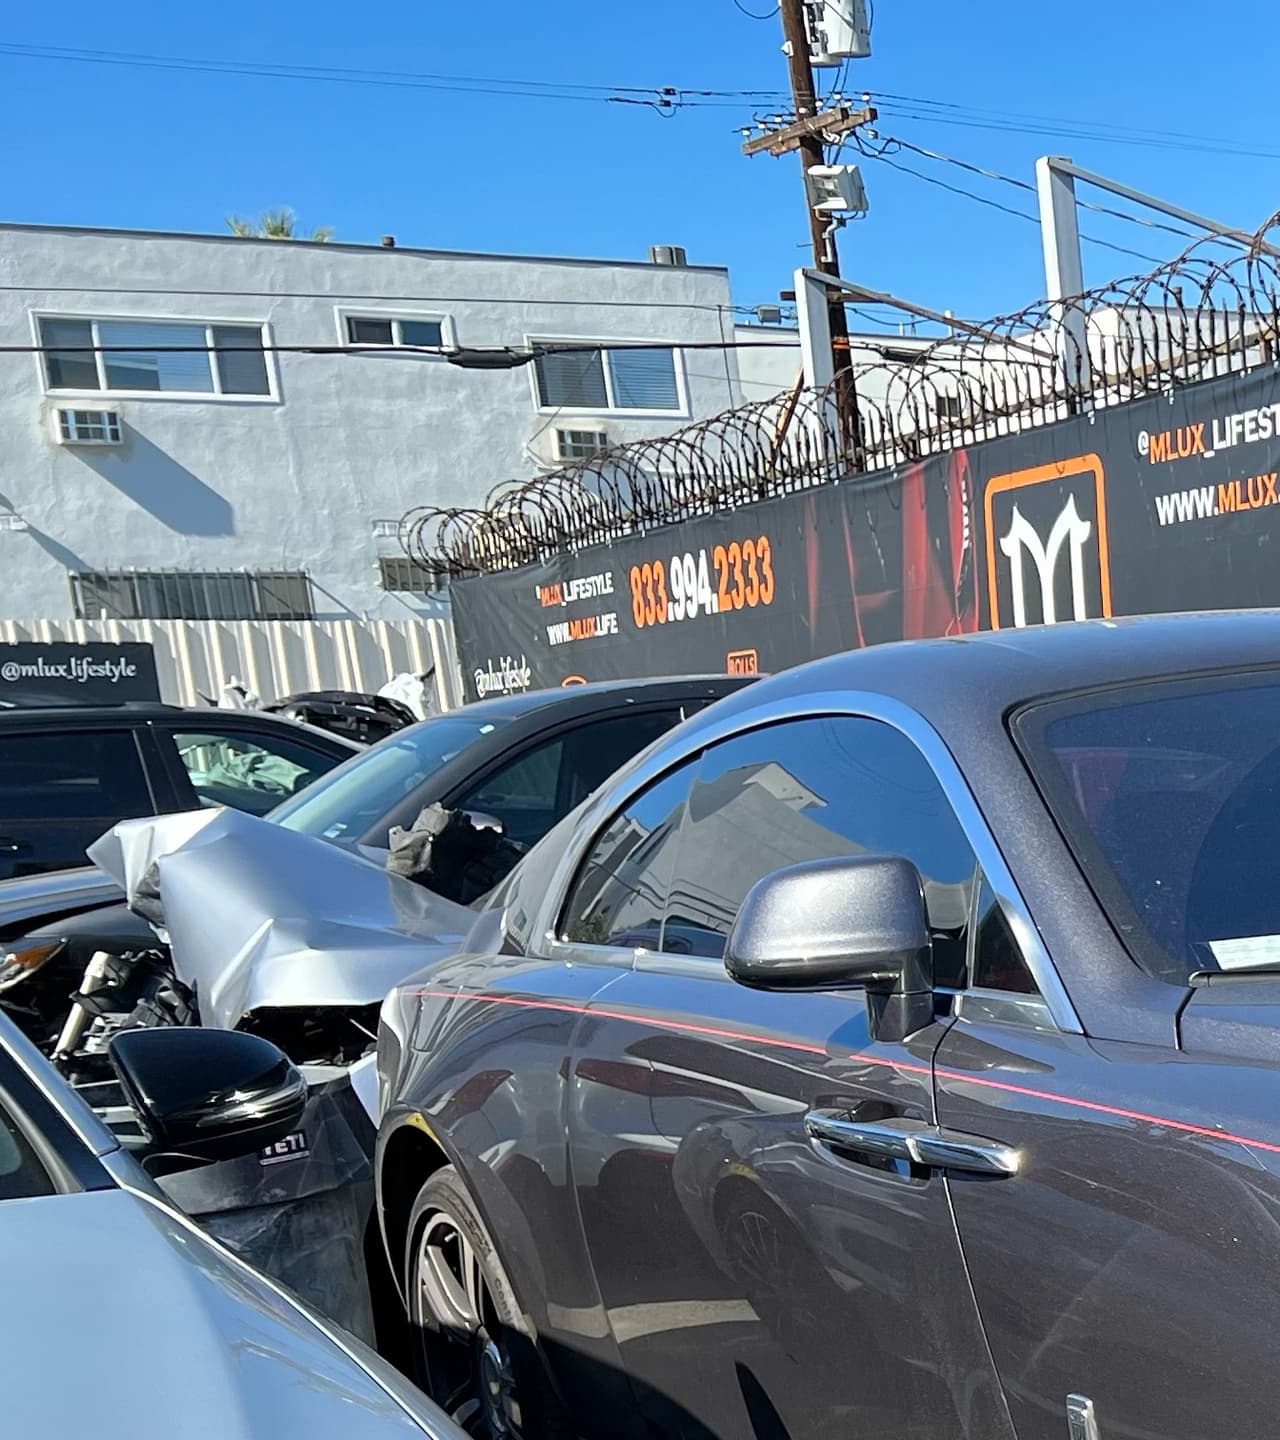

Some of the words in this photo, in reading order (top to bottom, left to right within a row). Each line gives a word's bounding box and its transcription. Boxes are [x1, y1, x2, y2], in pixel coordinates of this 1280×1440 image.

[630, 535, 776, 628] 833.994.2333
[547, 612, 618, 646] WWW.MLUX.LIFE
[1, 657, 137, 682] @mlux_lifestyle
